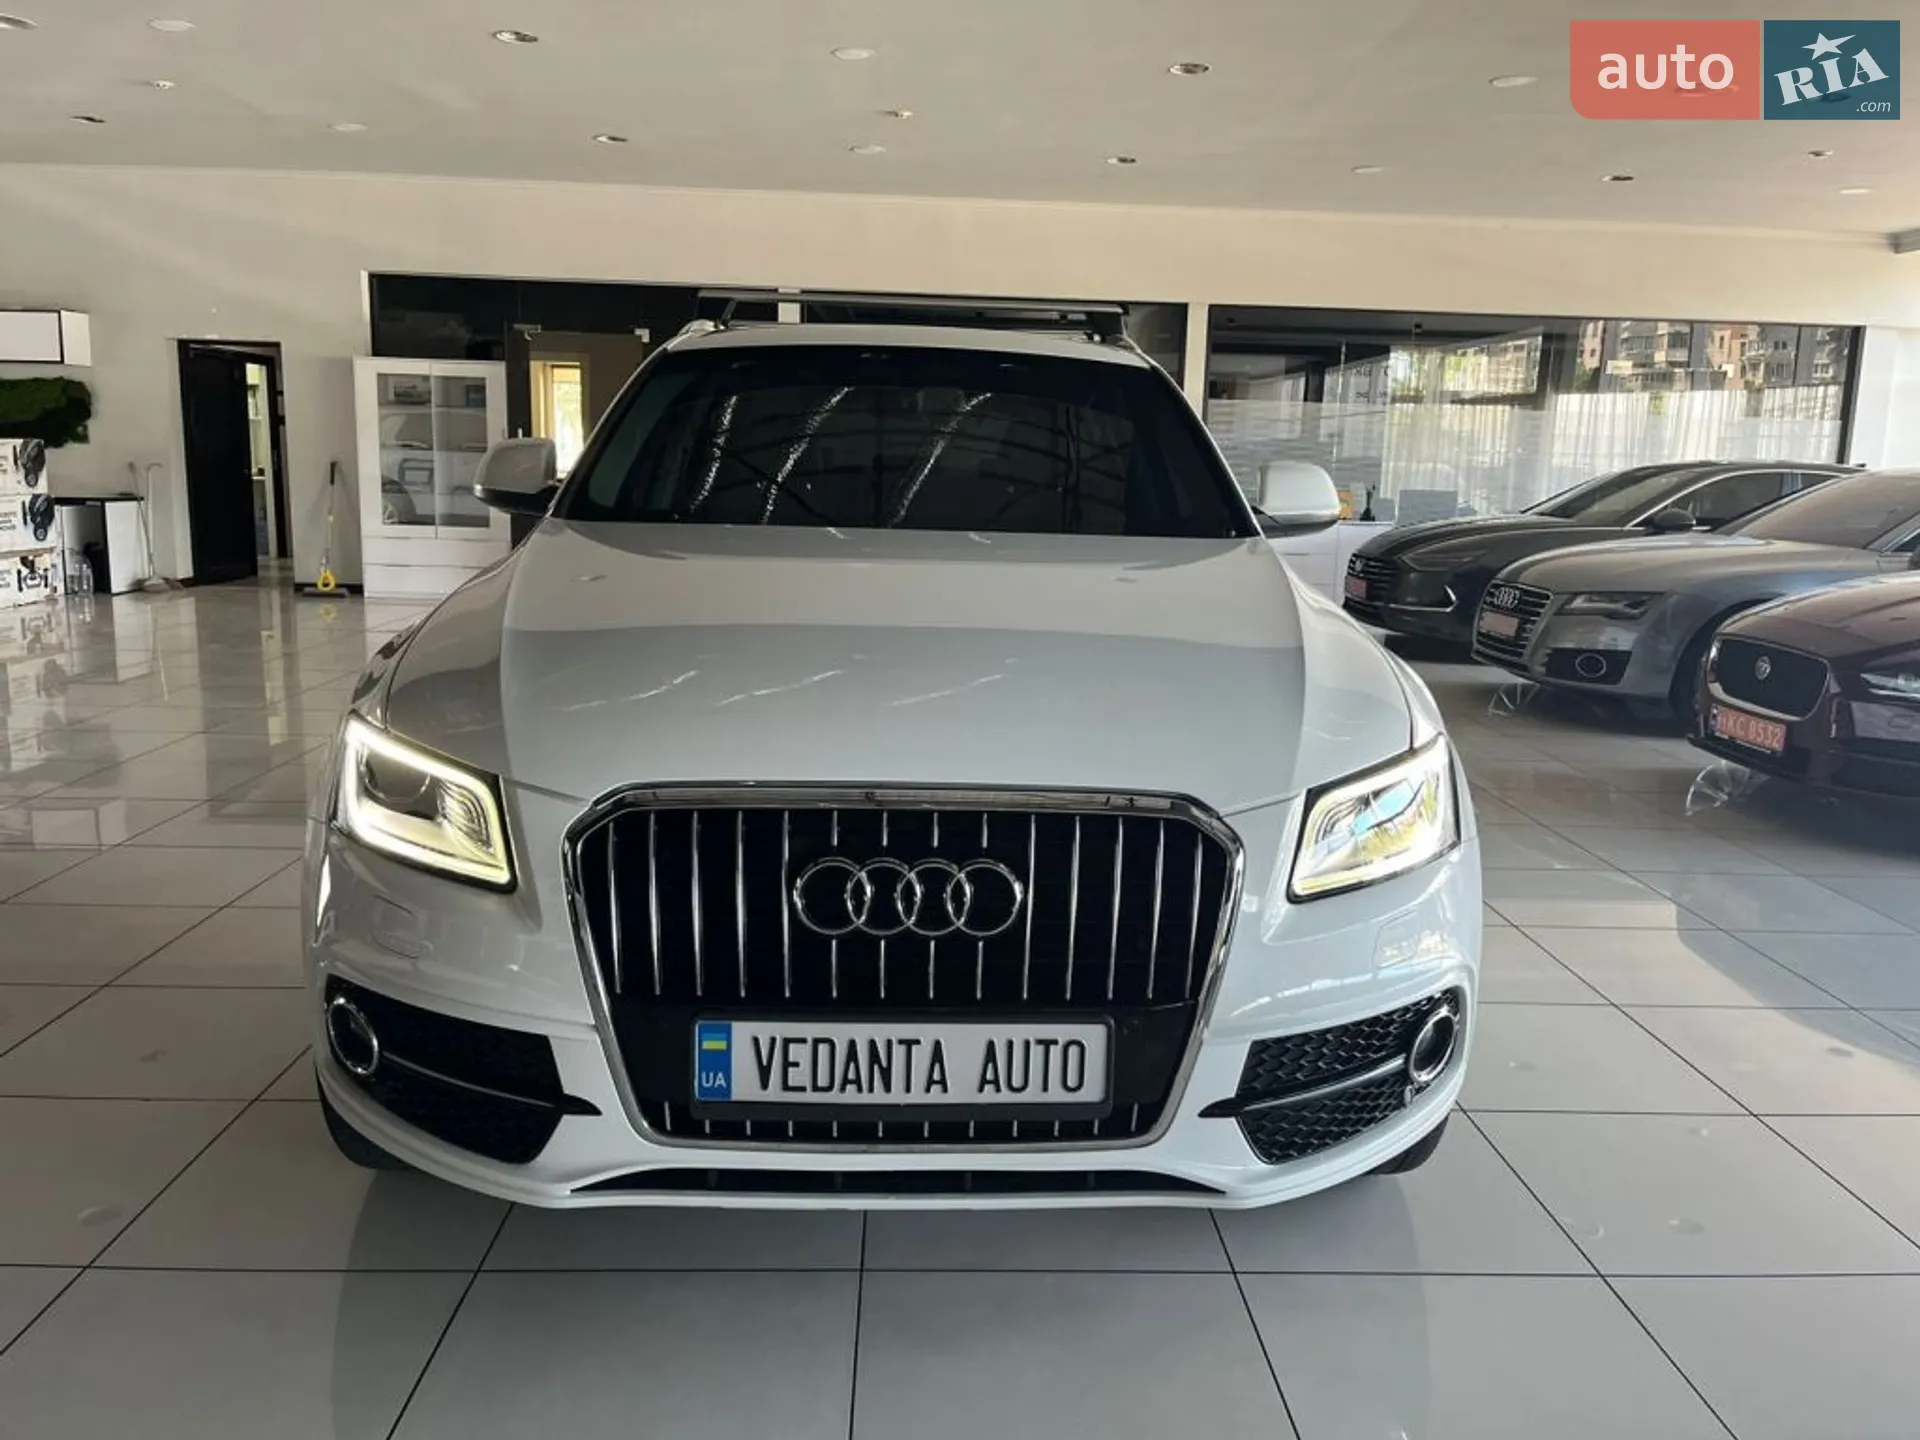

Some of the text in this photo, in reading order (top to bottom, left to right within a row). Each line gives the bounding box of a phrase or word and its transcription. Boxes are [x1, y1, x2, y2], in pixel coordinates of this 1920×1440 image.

[702, 1072, 727, 1089] UA
[752, 1036, 1087, 1094] VEDANTA AUTO
